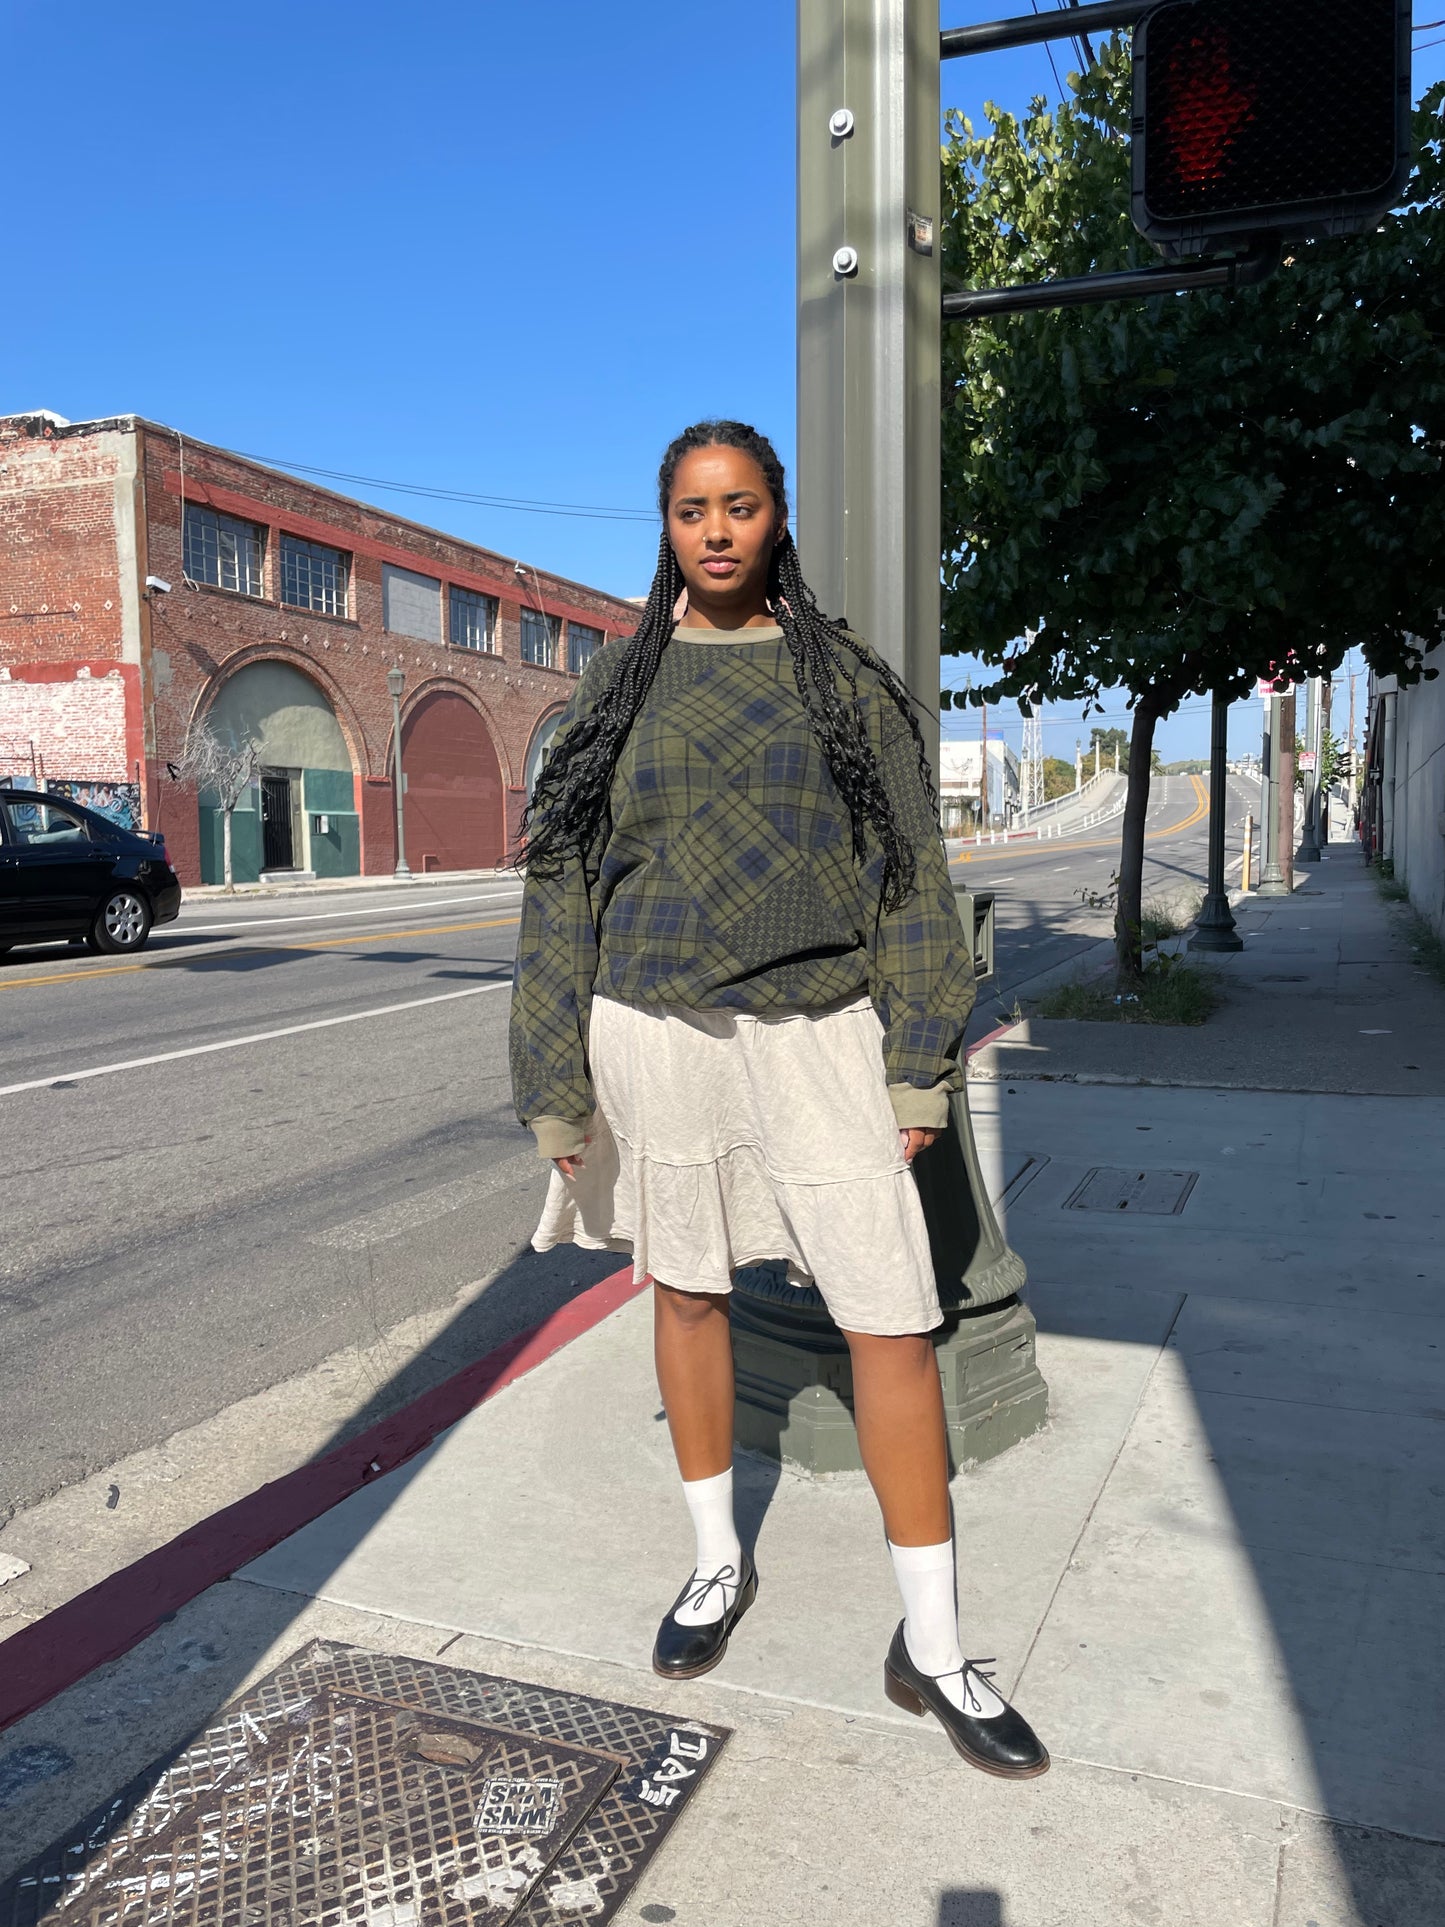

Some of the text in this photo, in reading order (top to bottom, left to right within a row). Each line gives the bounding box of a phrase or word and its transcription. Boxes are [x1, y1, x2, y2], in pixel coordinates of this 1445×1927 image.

[246, 1793, 377, 1917] UNITED
[298, 1792, 421, 1918] ASTING
[483, 1806, 548, 1826] SNM
